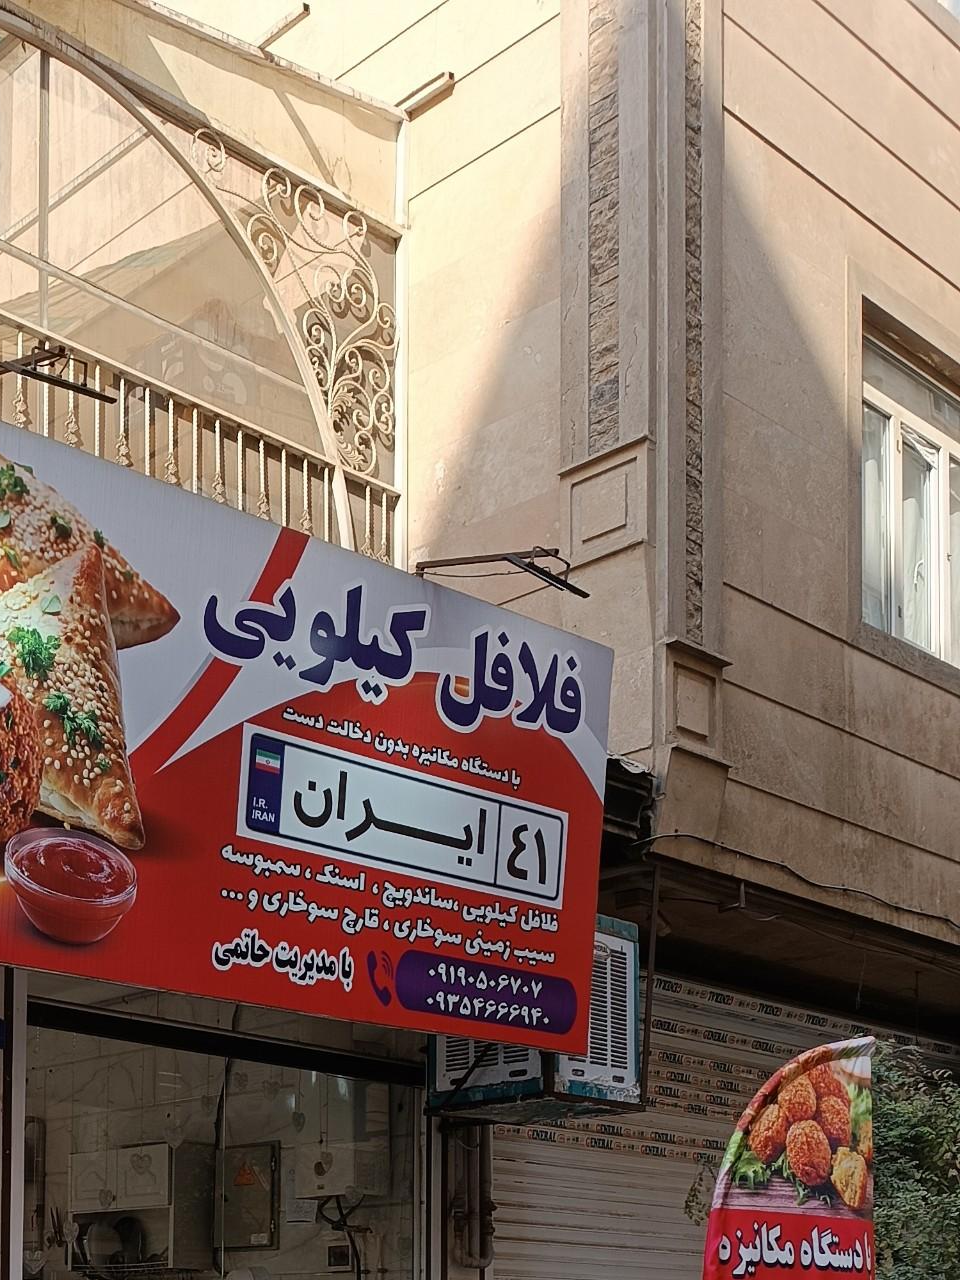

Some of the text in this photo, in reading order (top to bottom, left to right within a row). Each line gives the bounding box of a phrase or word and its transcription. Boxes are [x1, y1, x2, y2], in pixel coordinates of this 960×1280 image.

[202, 583, 583, 735] فلافل کیلویی
[282, 706, 522, 790] با دستگاه مکانیزه بدون دخالت دست
[251, 808, 276, 823] IRAN
[253, 796, 269, 811] I.R.
[293, 770, 487, 867] ایران
[221, 844, 302, 878] سمبوسه
[315, 865, 367, 893] اسنک
[247, 889, 260, 910] و
[262, 890, 340, 923] سوخاری
[462, 902, 519, 926] کیلویی
[341, 907, 380, 933] قارچ
[393, 916, 462, 948] سوخاری
[520, 908, 559, 932] فلافل
[213, 931, 354, 990] با مدیریت حاتمی
[464, 930, 511, 961] زمینی
[512, 946, 555, 965] سیب
[428, 962, 543, 999] ۰۹۱۹۰۵۰۶۷۰۷
[426, 991, 550, 1026] ۰۹۳۵۴۶۶۶۹۴۰
[717, 1220, 796, 1279] مکانیزه
[799, 1225, 864, 1273] دستگاه
